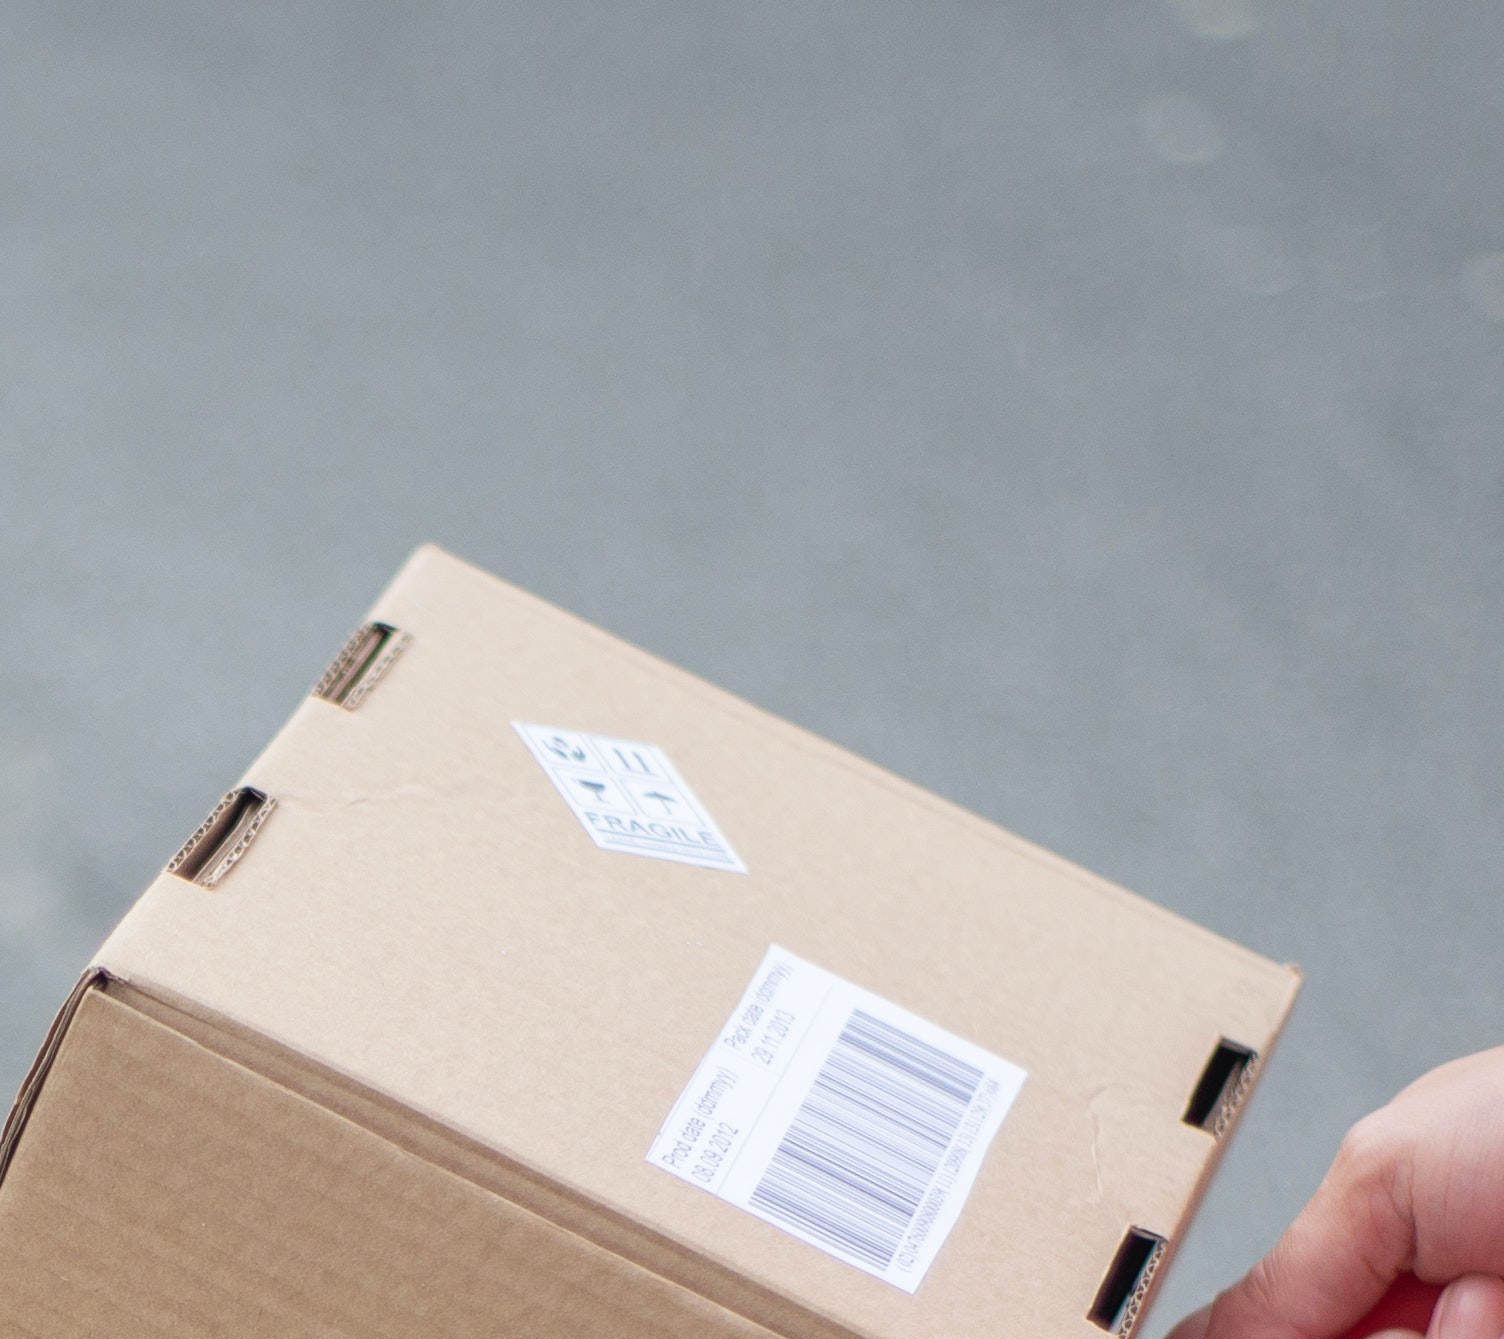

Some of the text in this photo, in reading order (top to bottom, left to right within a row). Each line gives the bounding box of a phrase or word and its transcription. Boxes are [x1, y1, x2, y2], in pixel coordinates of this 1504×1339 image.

[584, 811, 720, 847] FRAGILE
[724, 1023, 751, 1049] Pack
[741, 1003, 764, 1026] date
[662, 1066, 738, 1168] Prod date (ddmmyy)
[691, 1122, 739, 1183] 08.09.2012
